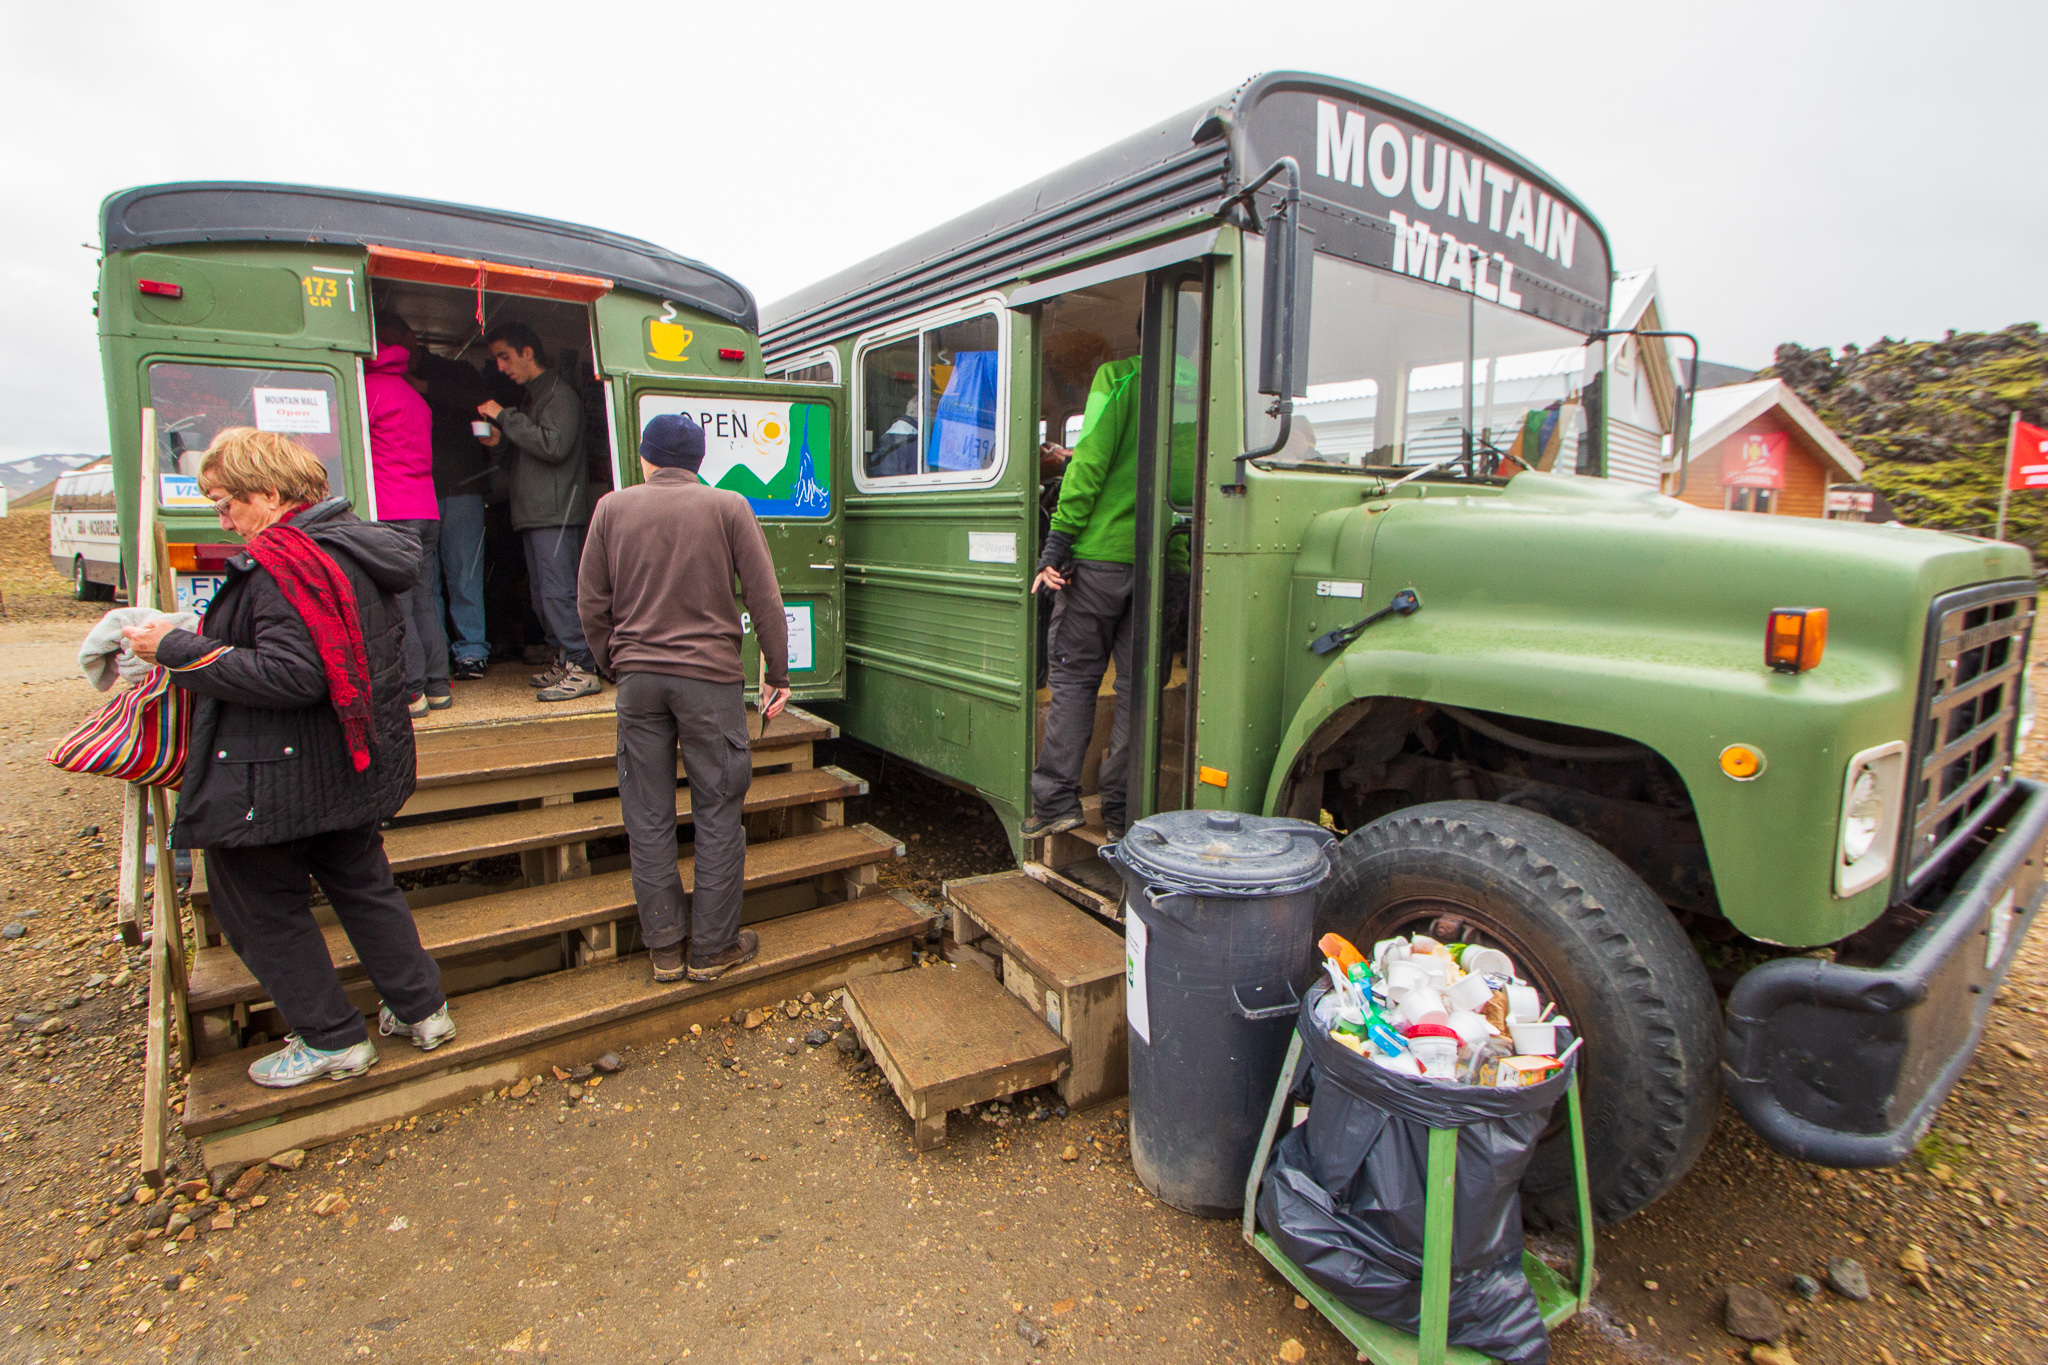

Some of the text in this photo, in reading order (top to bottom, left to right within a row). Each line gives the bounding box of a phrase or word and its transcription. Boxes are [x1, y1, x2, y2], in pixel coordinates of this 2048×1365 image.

[1316, 98, 1578, 270] MOUNTAIN
[1389, 209, 1522, 310] MALL
[301, 276, 338, 297] 173
[308, 296, 332, 307] CM
[264, 395, 318, 406] MOUNTAIN MALL
[276, 408, 310, 417] Open
[680, 411, 748, 438] PEN
[175, 485, 201, 496] VIS
